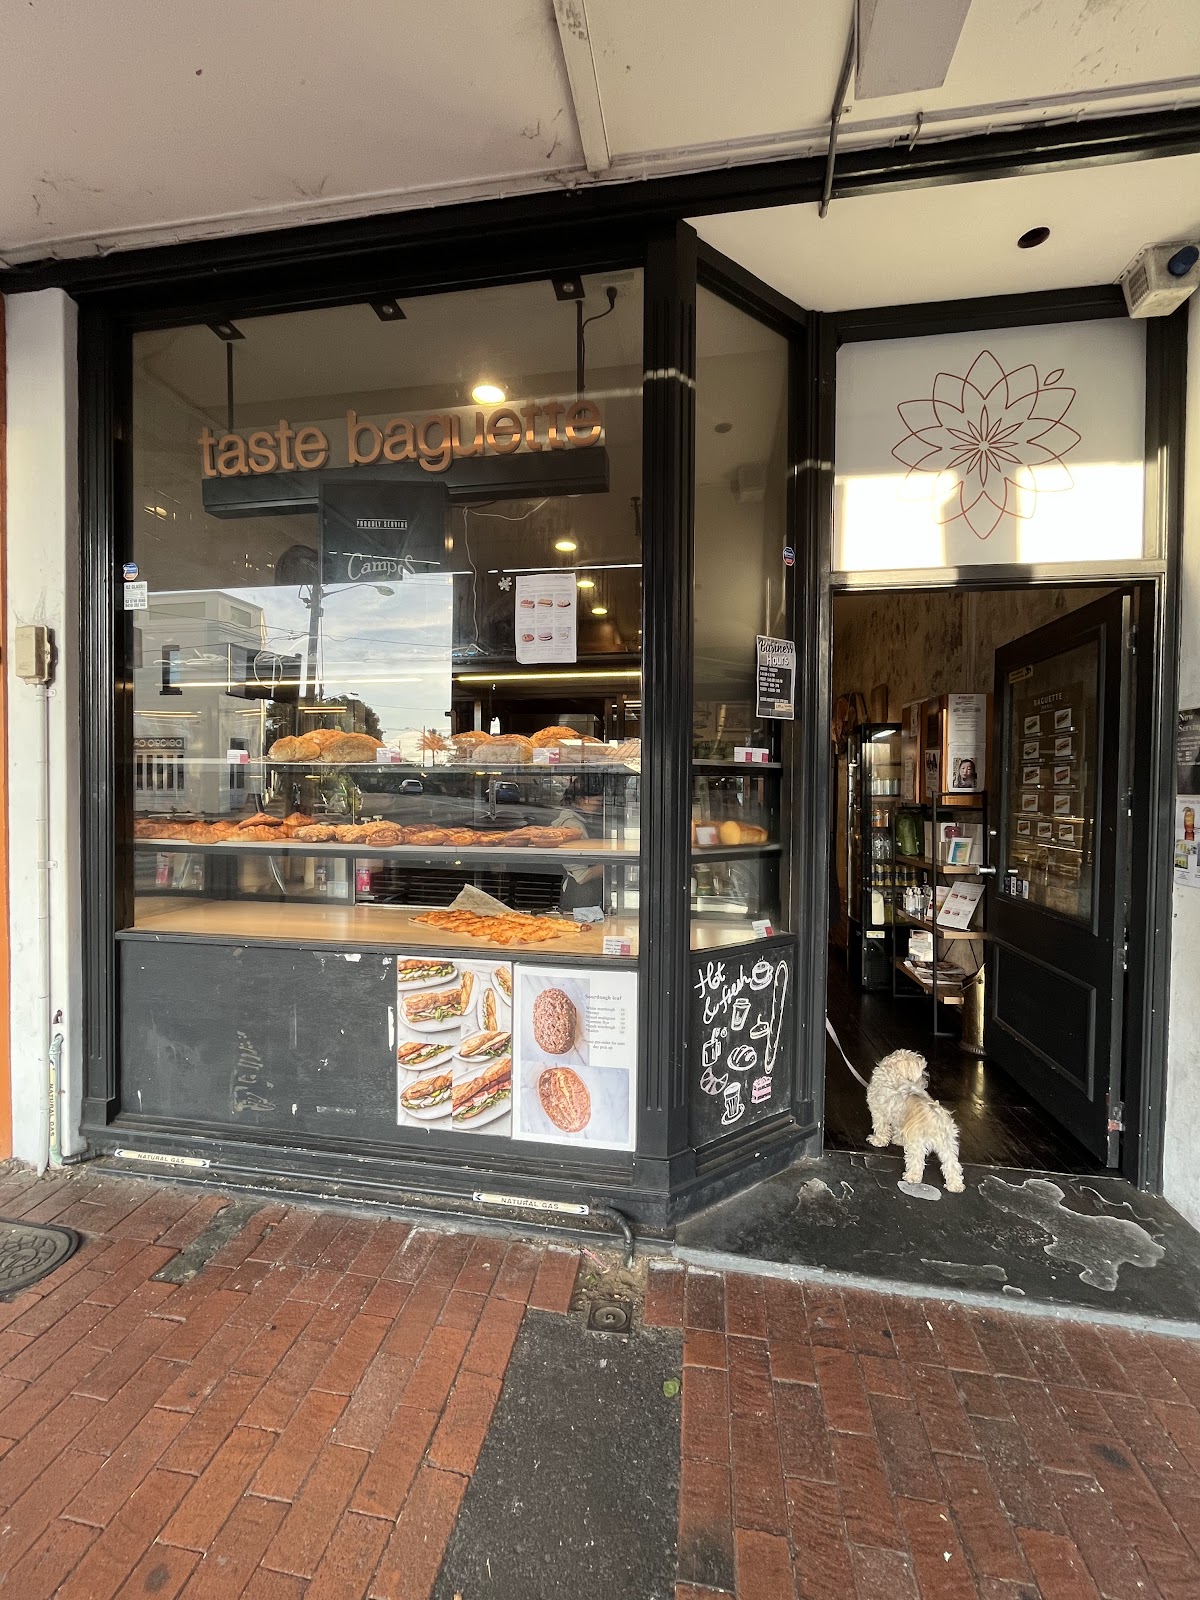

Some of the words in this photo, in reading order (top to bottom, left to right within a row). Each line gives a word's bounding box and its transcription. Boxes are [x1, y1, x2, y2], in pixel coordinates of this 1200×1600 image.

[198, 419, 329, 478] taste
[347, 399, 601, 473] baguette
[759, 639, 794, 654] Business
[766, 654, 789, 666] Hours
[1178, 723, 1200, 732] Servin
[694, 961, 726, 998] Hot
[138, 1153, 168, 1162] NATURAL
[501, 1197, 539, 1207] NATURAL
[541, 1202, 559, 1210] GAS
